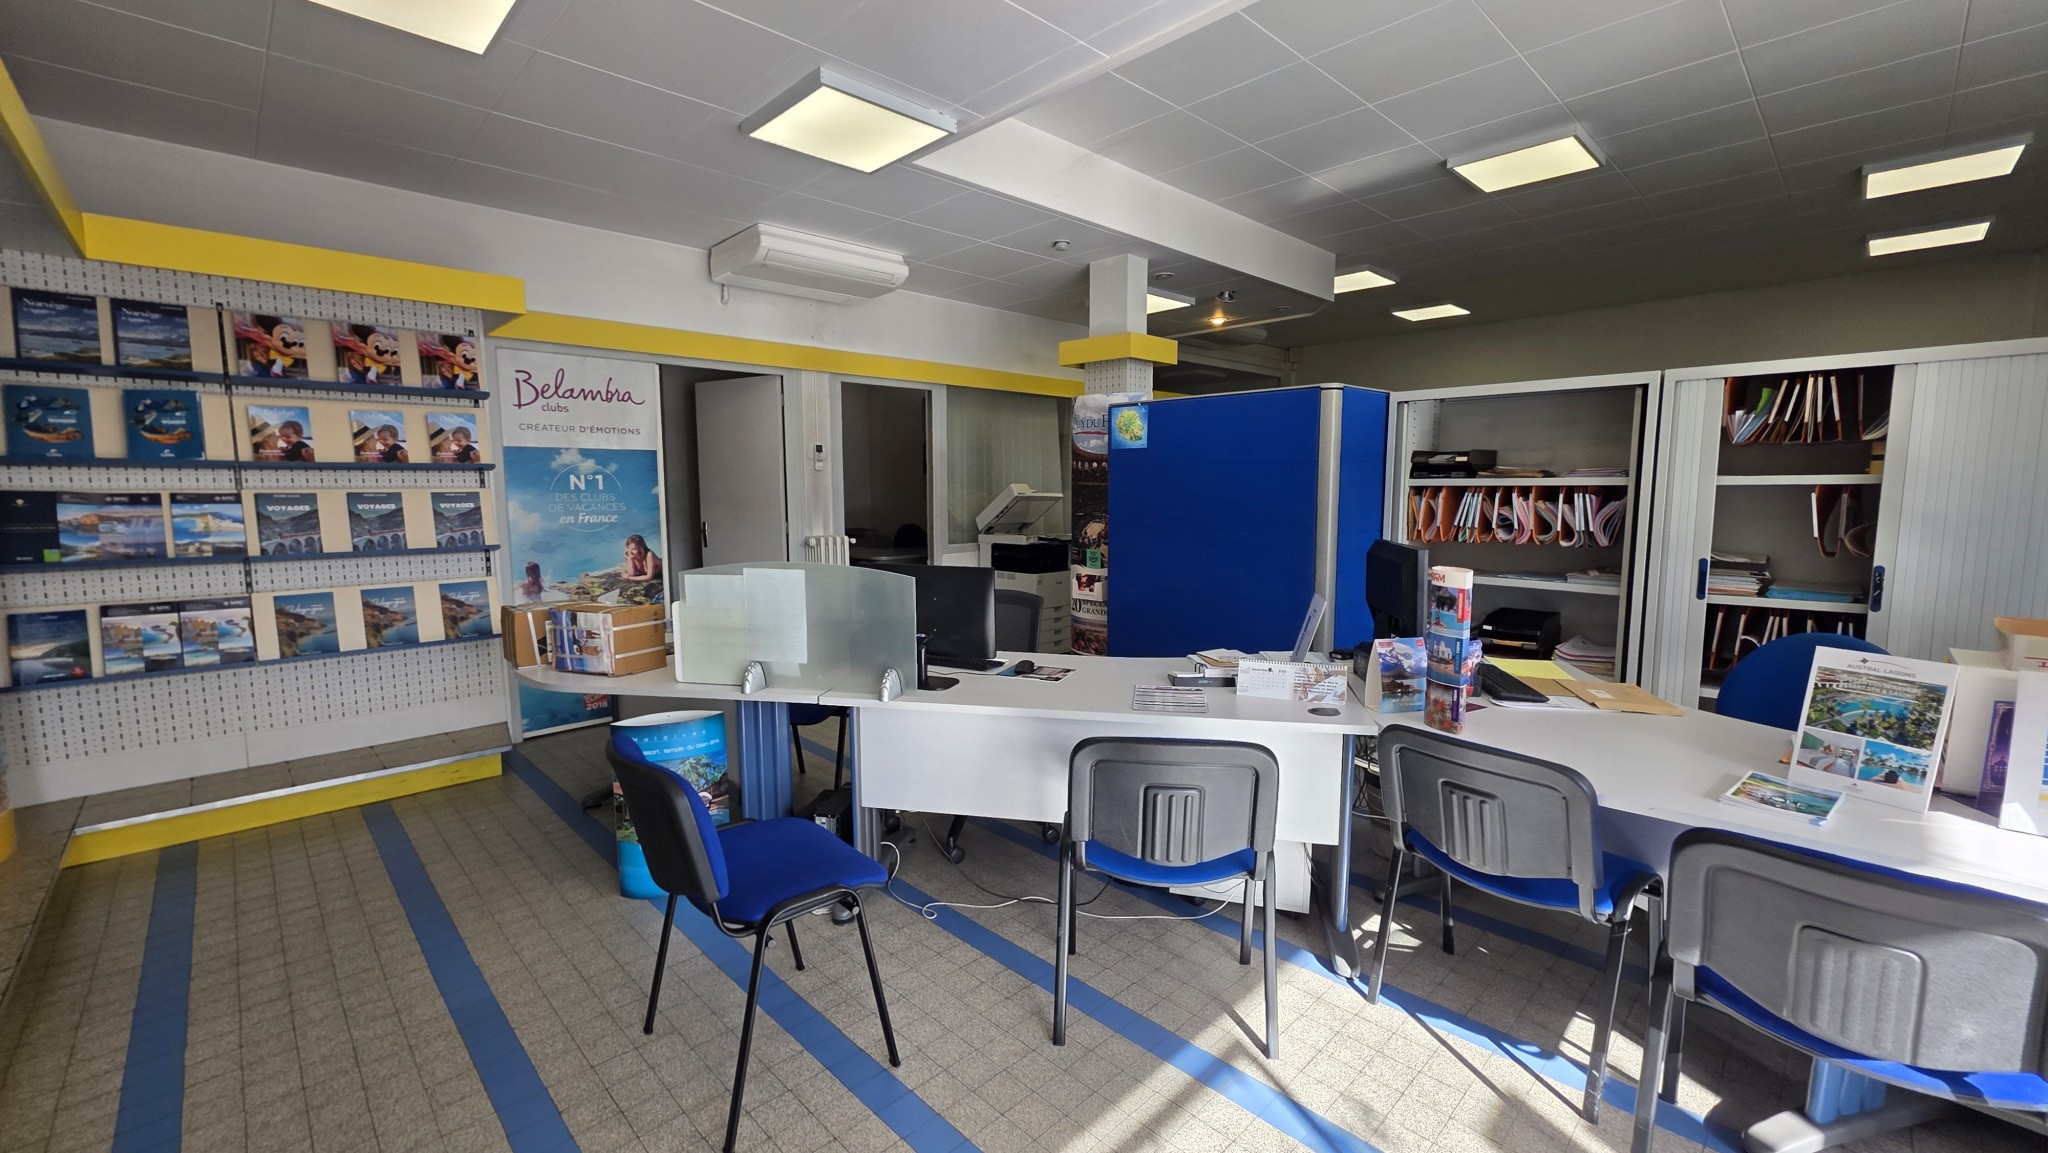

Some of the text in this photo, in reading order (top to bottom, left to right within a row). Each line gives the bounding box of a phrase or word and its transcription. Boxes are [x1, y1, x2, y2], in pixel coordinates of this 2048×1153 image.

[513, 368, 645, 409] Belambra
[541, 403, 569, 413] clubs
[519, 423, 641, 435] CRÉATEUR D'ÉMOTIONS
[569, 474, 604, 491] N°1
[555, 493, 616, 501] DES CLUBS
[266, 504, 311, 512] VOYAGES
[550, 503, 626, 512] DE VACANCES
[559, 513, 619, 524] en France
[1082, 607, 1106, 616] GRAND
[1847, 663, 1917, 679] AUSTRAL LAGONS
